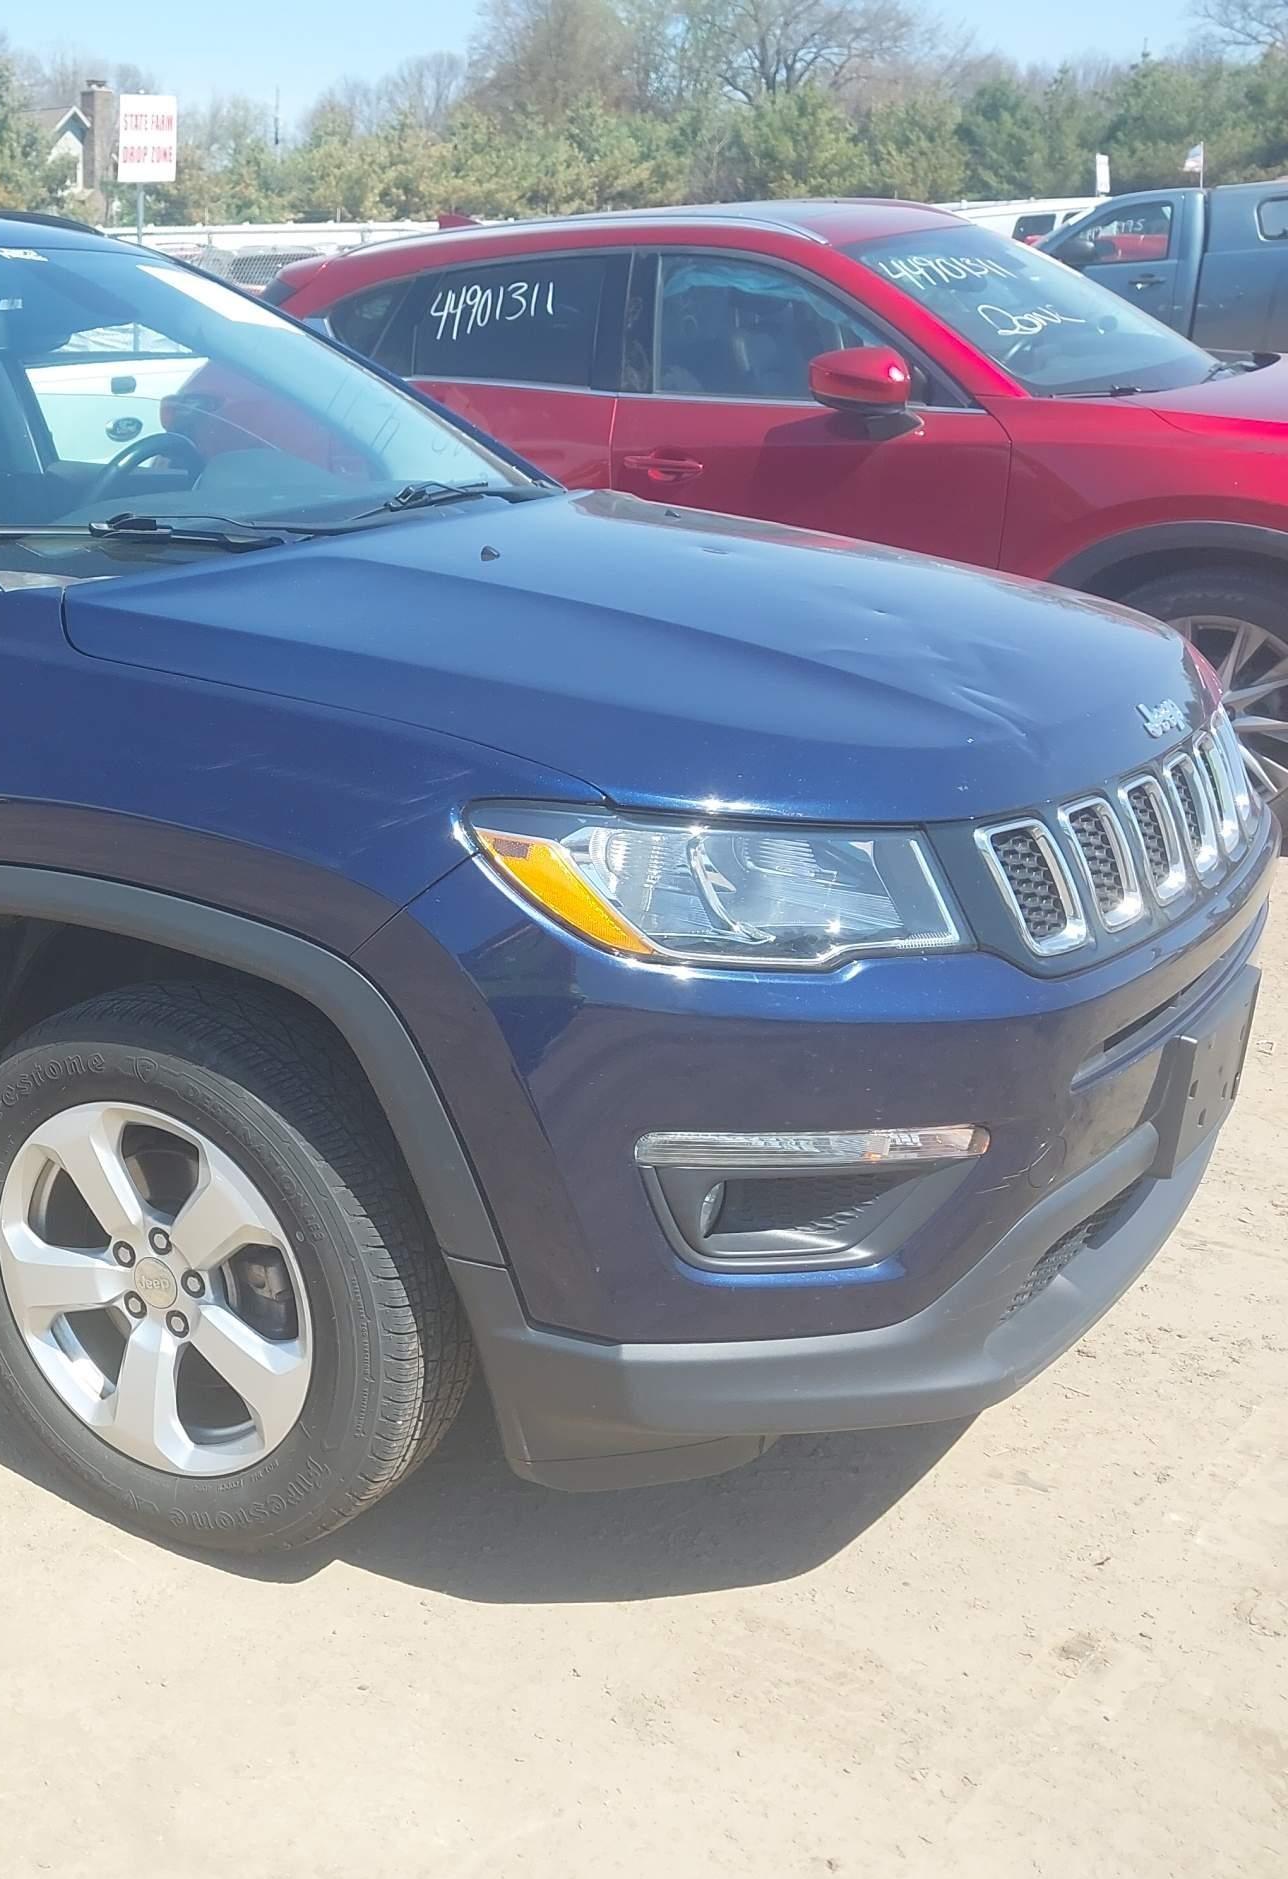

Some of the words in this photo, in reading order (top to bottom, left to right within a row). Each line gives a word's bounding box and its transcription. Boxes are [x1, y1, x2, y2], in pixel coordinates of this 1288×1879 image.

[123, 114, 148, 131] STATE
[151, 114, 174, 131] FARM
[122, 146, 148, 163] DROP
[151, 146, 173, 163] ZONE
[878, 255, 1017, 290] 44901311
[430, 281, 554, 341] 44901311
[139, 1275, 170, 1291] Jeep
